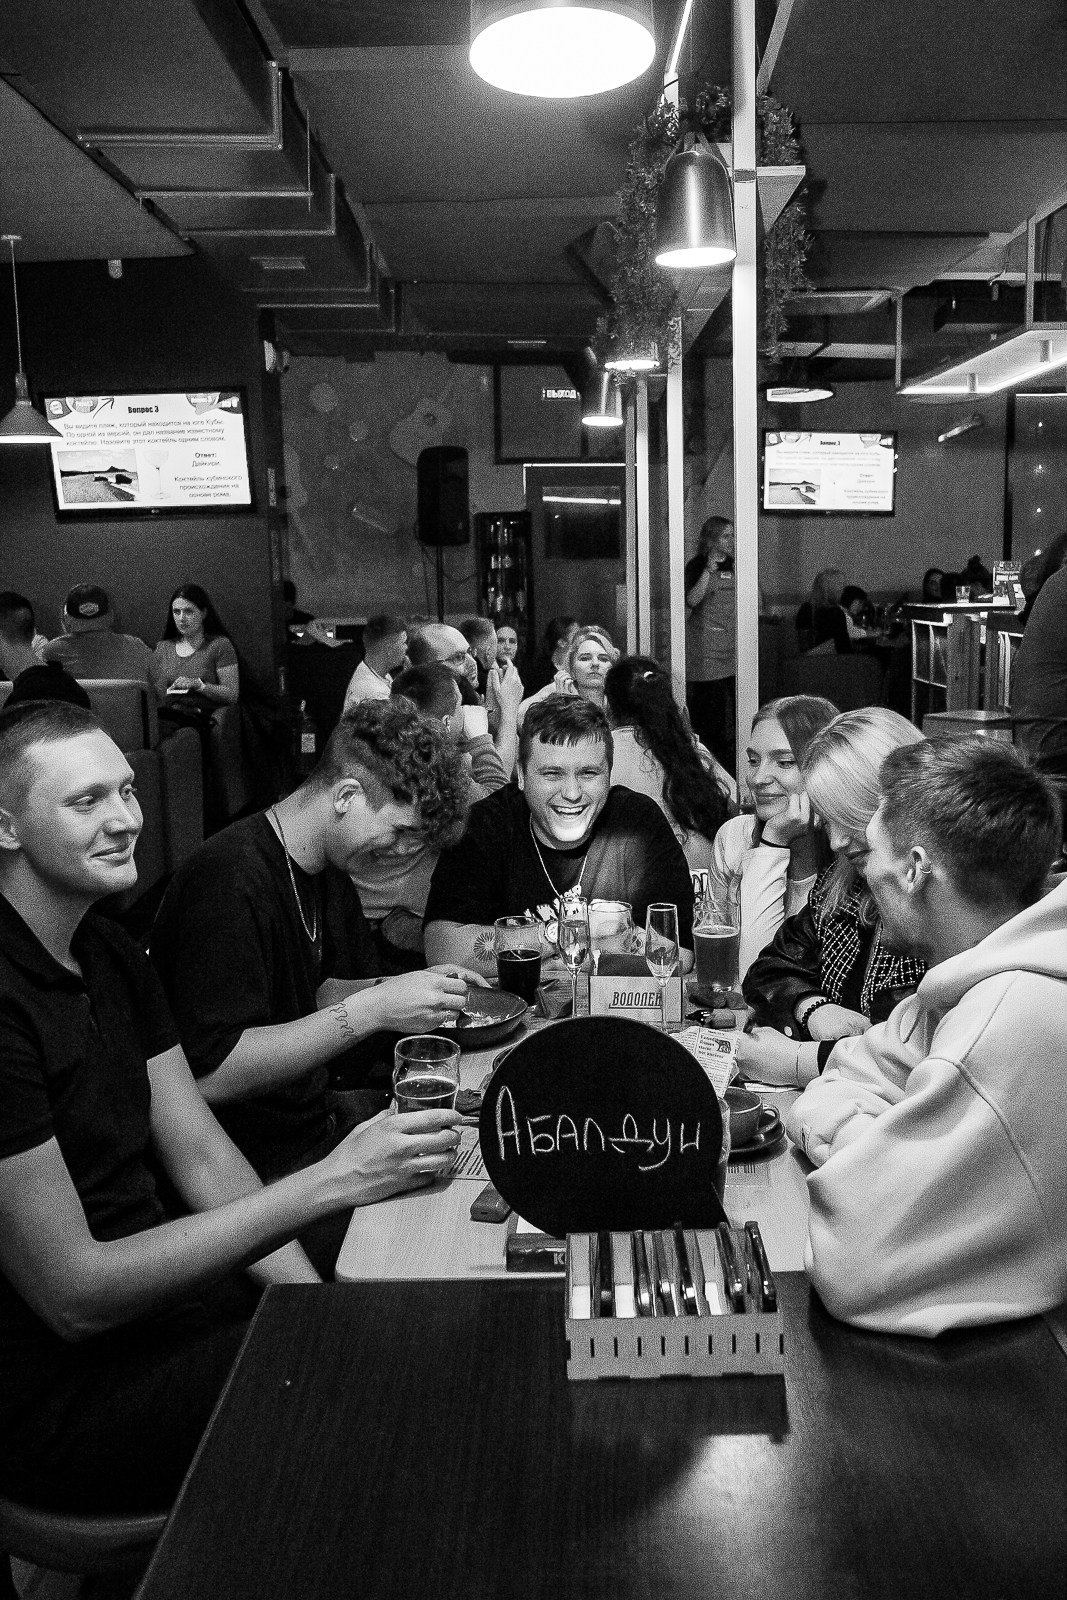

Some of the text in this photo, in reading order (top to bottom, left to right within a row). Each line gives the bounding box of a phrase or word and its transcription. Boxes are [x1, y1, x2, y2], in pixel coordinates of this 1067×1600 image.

[546, 389, 577, 399] ВЫХОД
[127, 405, 159, 414] Вопрос 3
[119, 421, 147, 429] который
[148, 420, 181, 428] находится
[76, 431, 96, 439] одной
[147, 436, 178, 444] коктейль
[206, 474, 243, 482] кубинского
